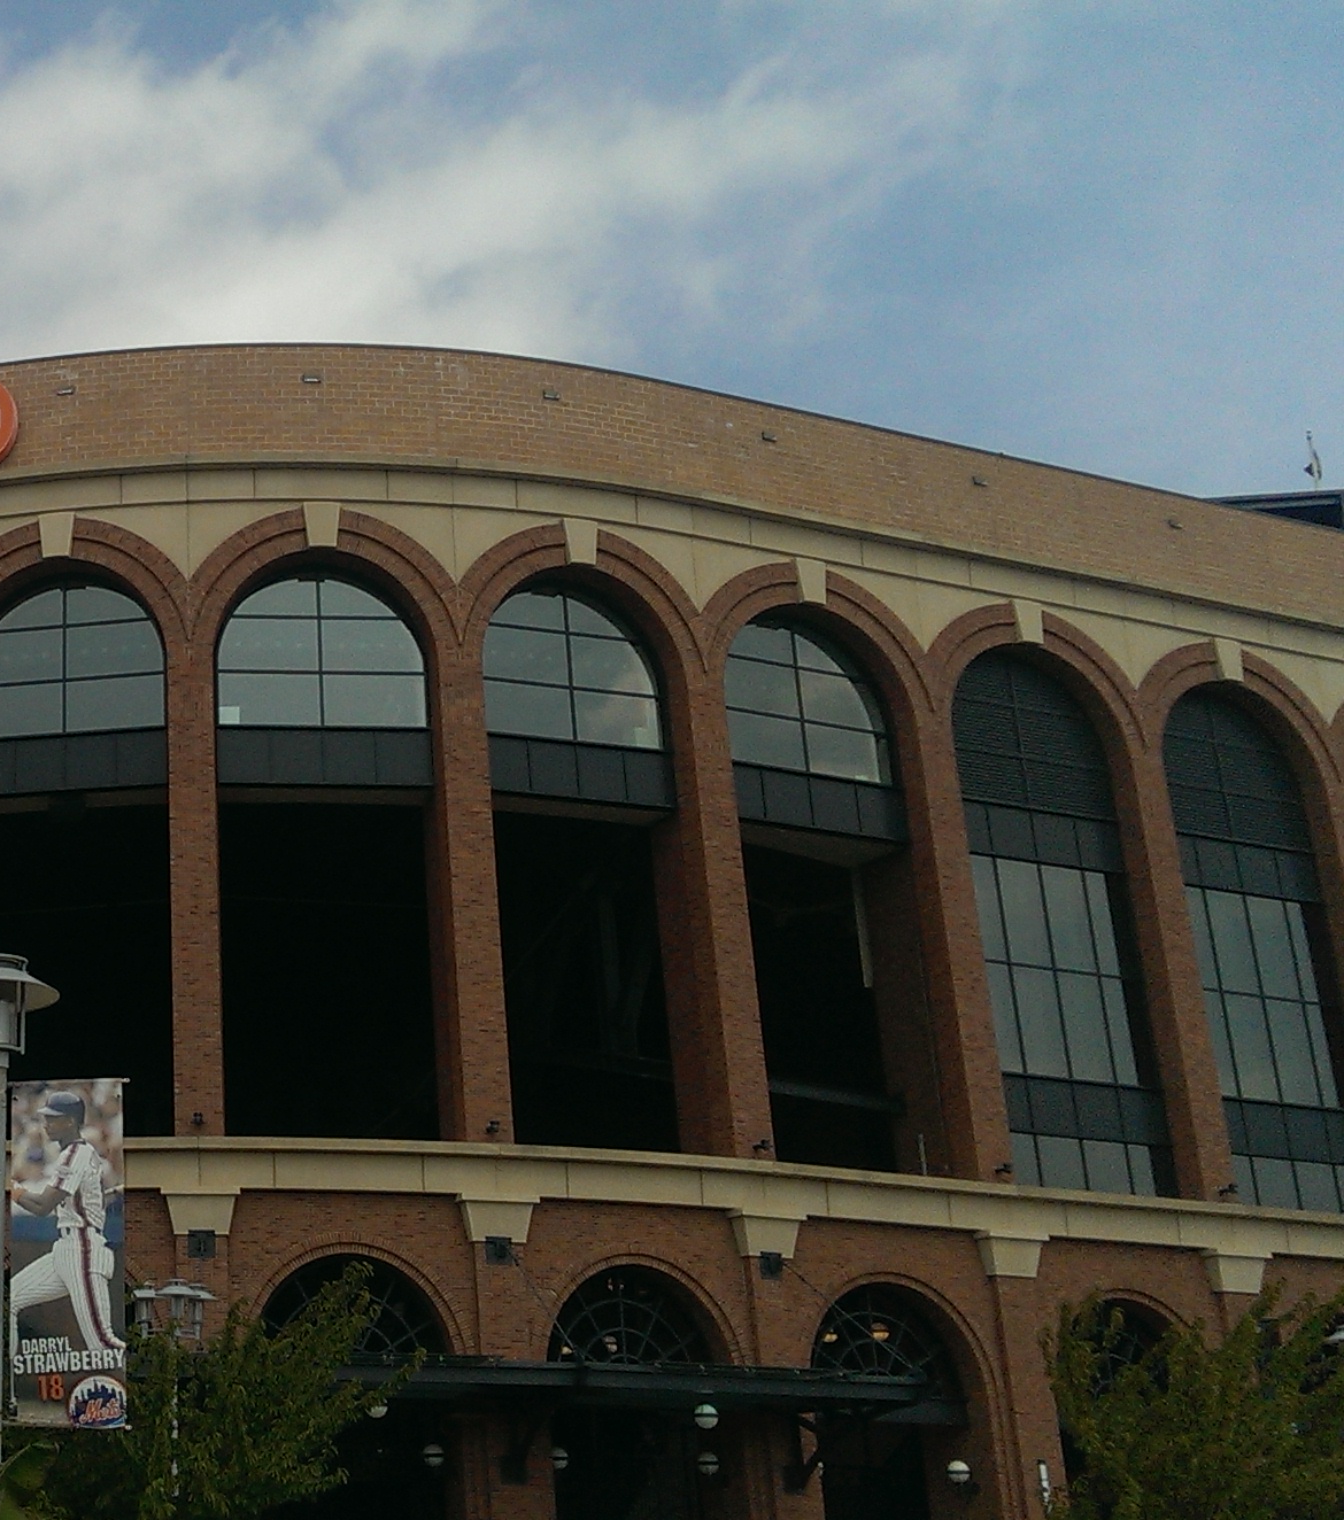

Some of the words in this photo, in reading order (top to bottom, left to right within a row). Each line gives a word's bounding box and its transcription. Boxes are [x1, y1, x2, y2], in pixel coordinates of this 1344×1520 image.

[22, 1336, 72, 1354] DARRYL
[13, 1349, 125, 1375] STRAWBERRY
[38, 1374, 65, 1401] 18
[79, 1398, 122, 1424] Mets
